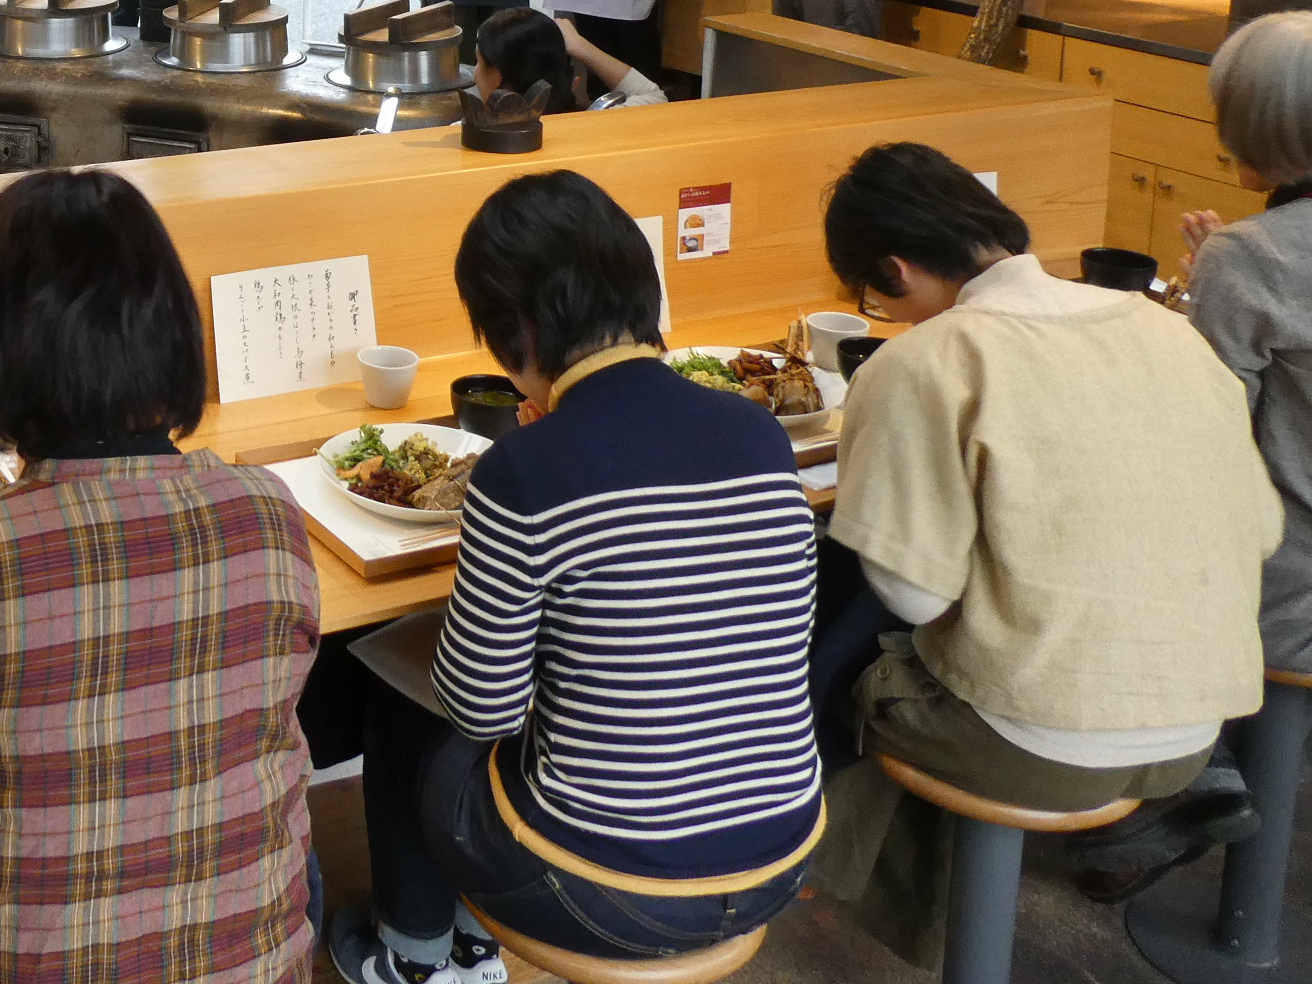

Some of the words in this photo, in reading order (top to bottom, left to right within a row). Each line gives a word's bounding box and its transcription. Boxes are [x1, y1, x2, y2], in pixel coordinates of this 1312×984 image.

[348, 290, 359, 335] 御品書き
[482, 969, 503, 981] NIKE
